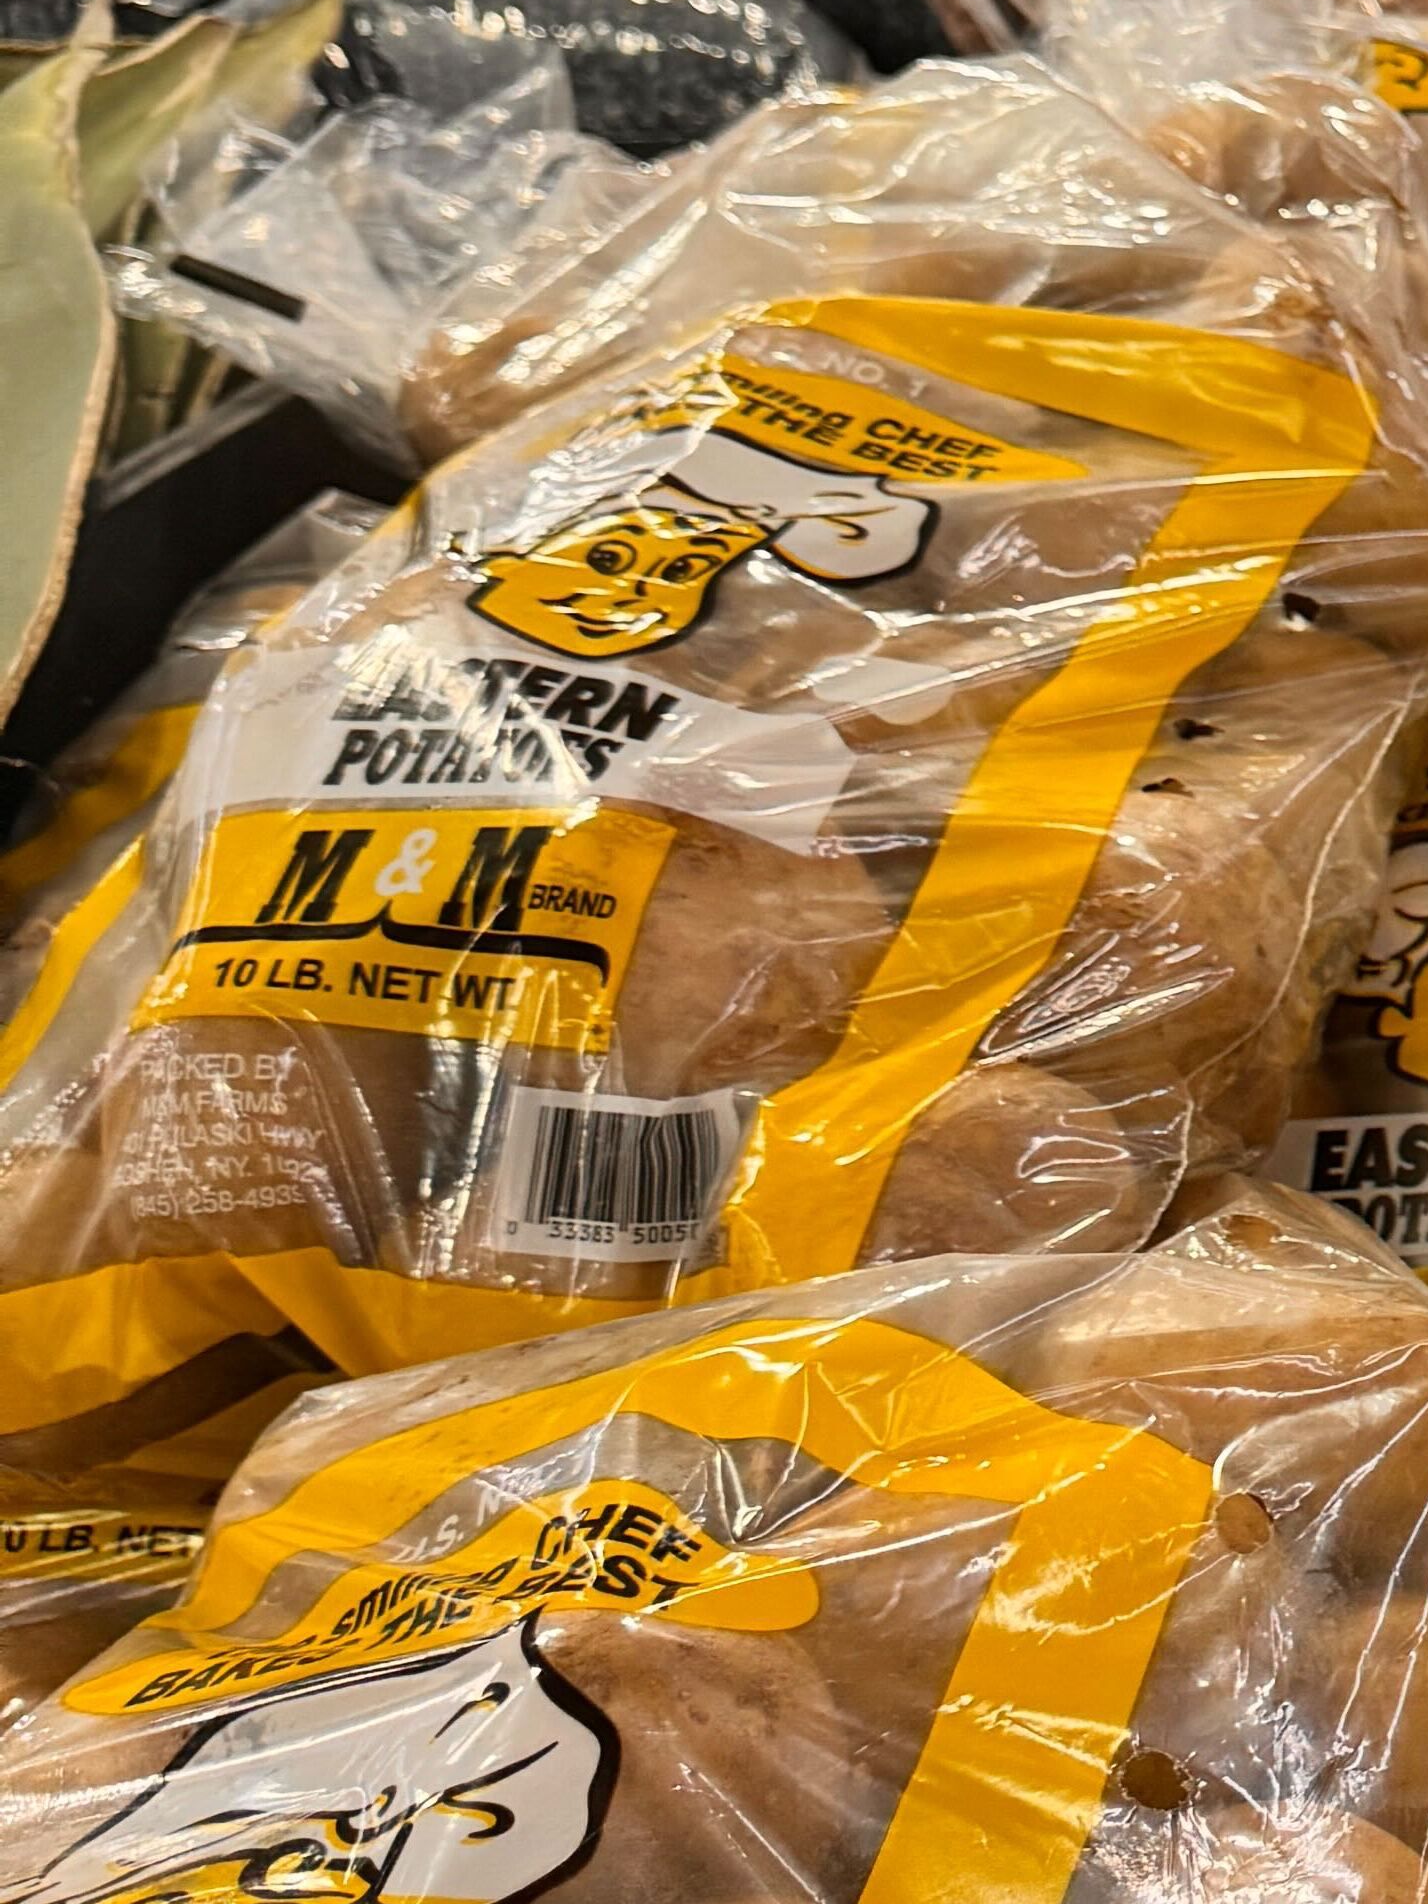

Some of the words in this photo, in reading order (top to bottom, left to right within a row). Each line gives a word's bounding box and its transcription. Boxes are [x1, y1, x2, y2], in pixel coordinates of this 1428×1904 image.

[737, 396, 845, 447] THE
[850, 441, 1001, 480] BEST
[865, 418, 1004, 459] CHEF
[255, 826, 373, 926] M
[441, 826, 555, 934] M
[528, 882, 617, 923] BRAND
[213, 958, 259, 991] 10
[268, 956, 334, 994] LB.
[348, 966, 442, 1003] NET
[550, 1220, 615, 1243] 33383
[530, 1502, 704, 1571] CHEF
[364, 1589, 490, 1651] THE
[501, 1553, 704, 1613] BEST
